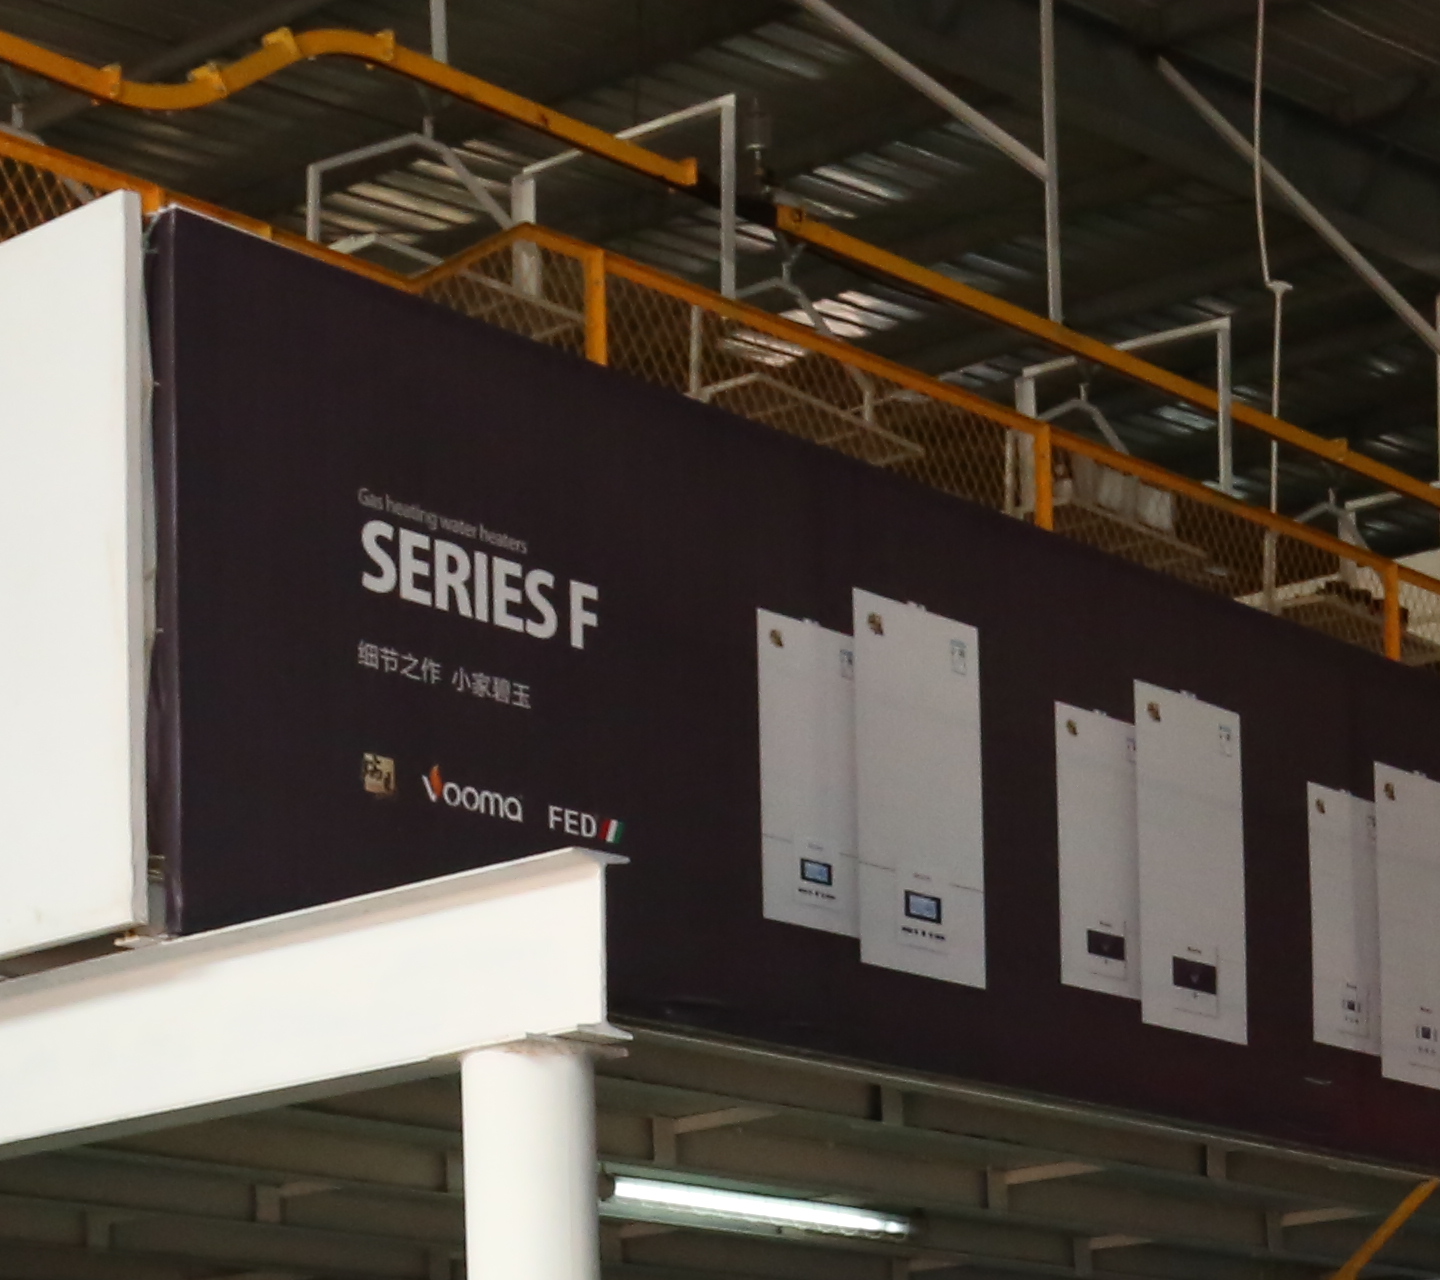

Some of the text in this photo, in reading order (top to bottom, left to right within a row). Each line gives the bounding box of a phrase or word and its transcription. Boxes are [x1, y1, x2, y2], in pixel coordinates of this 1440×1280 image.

[361, 522, 599, 650] SERIES F
[358, 639, 442, 684] 细节之作
